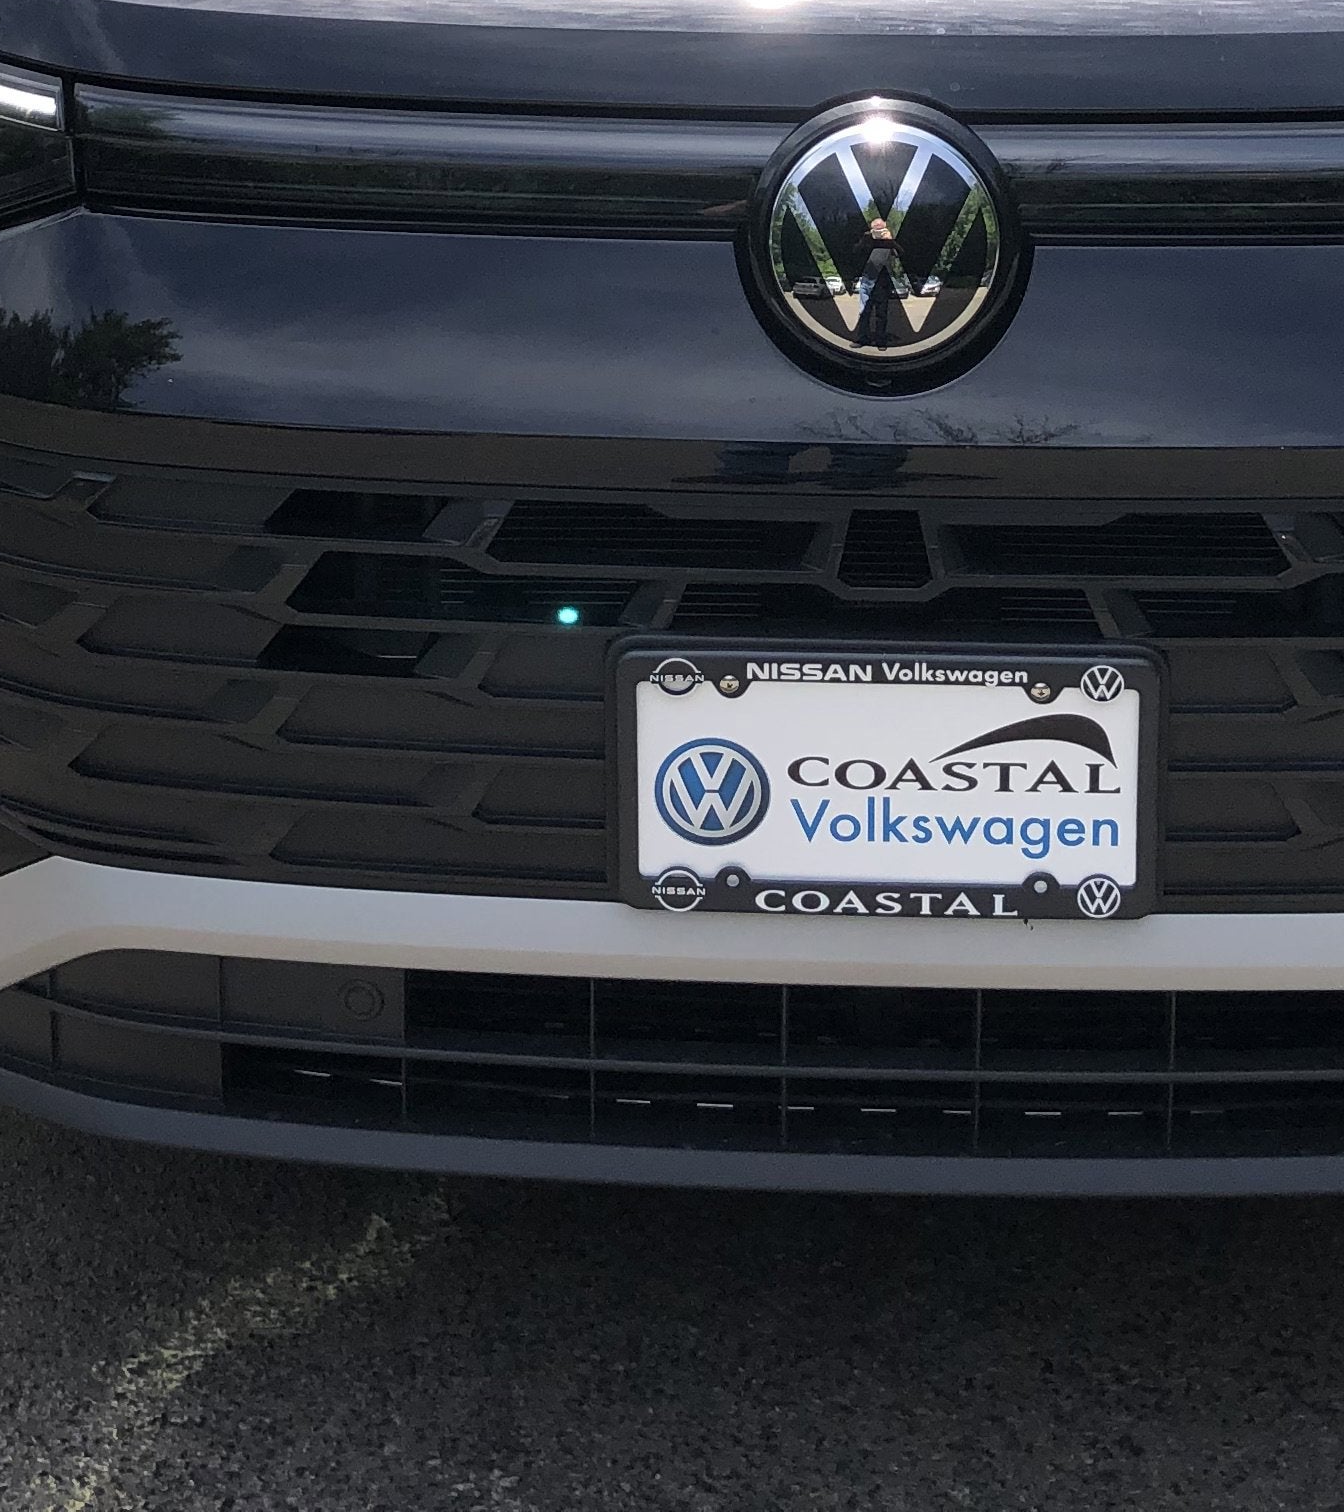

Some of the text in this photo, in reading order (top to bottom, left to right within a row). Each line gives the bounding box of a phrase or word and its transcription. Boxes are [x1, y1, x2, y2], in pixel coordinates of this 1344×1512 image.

[772, 134, 996, 340] VW
[649, 674, 705, 683] NISSAN
[746, 662, 1028, 688] NISSAN Volkswagen
[1082, 666, 1123, 702] VW
[662, 745, 761, 837] VW
[787, 756, 1121, 794] COASTAL
[790, 795, 1120, 861] Volkswagen
[651, 885, 706, 896] NISSAN
[754, 889, 1018, 916] COASTAL
[1078, 879, 1120, 917] VW
